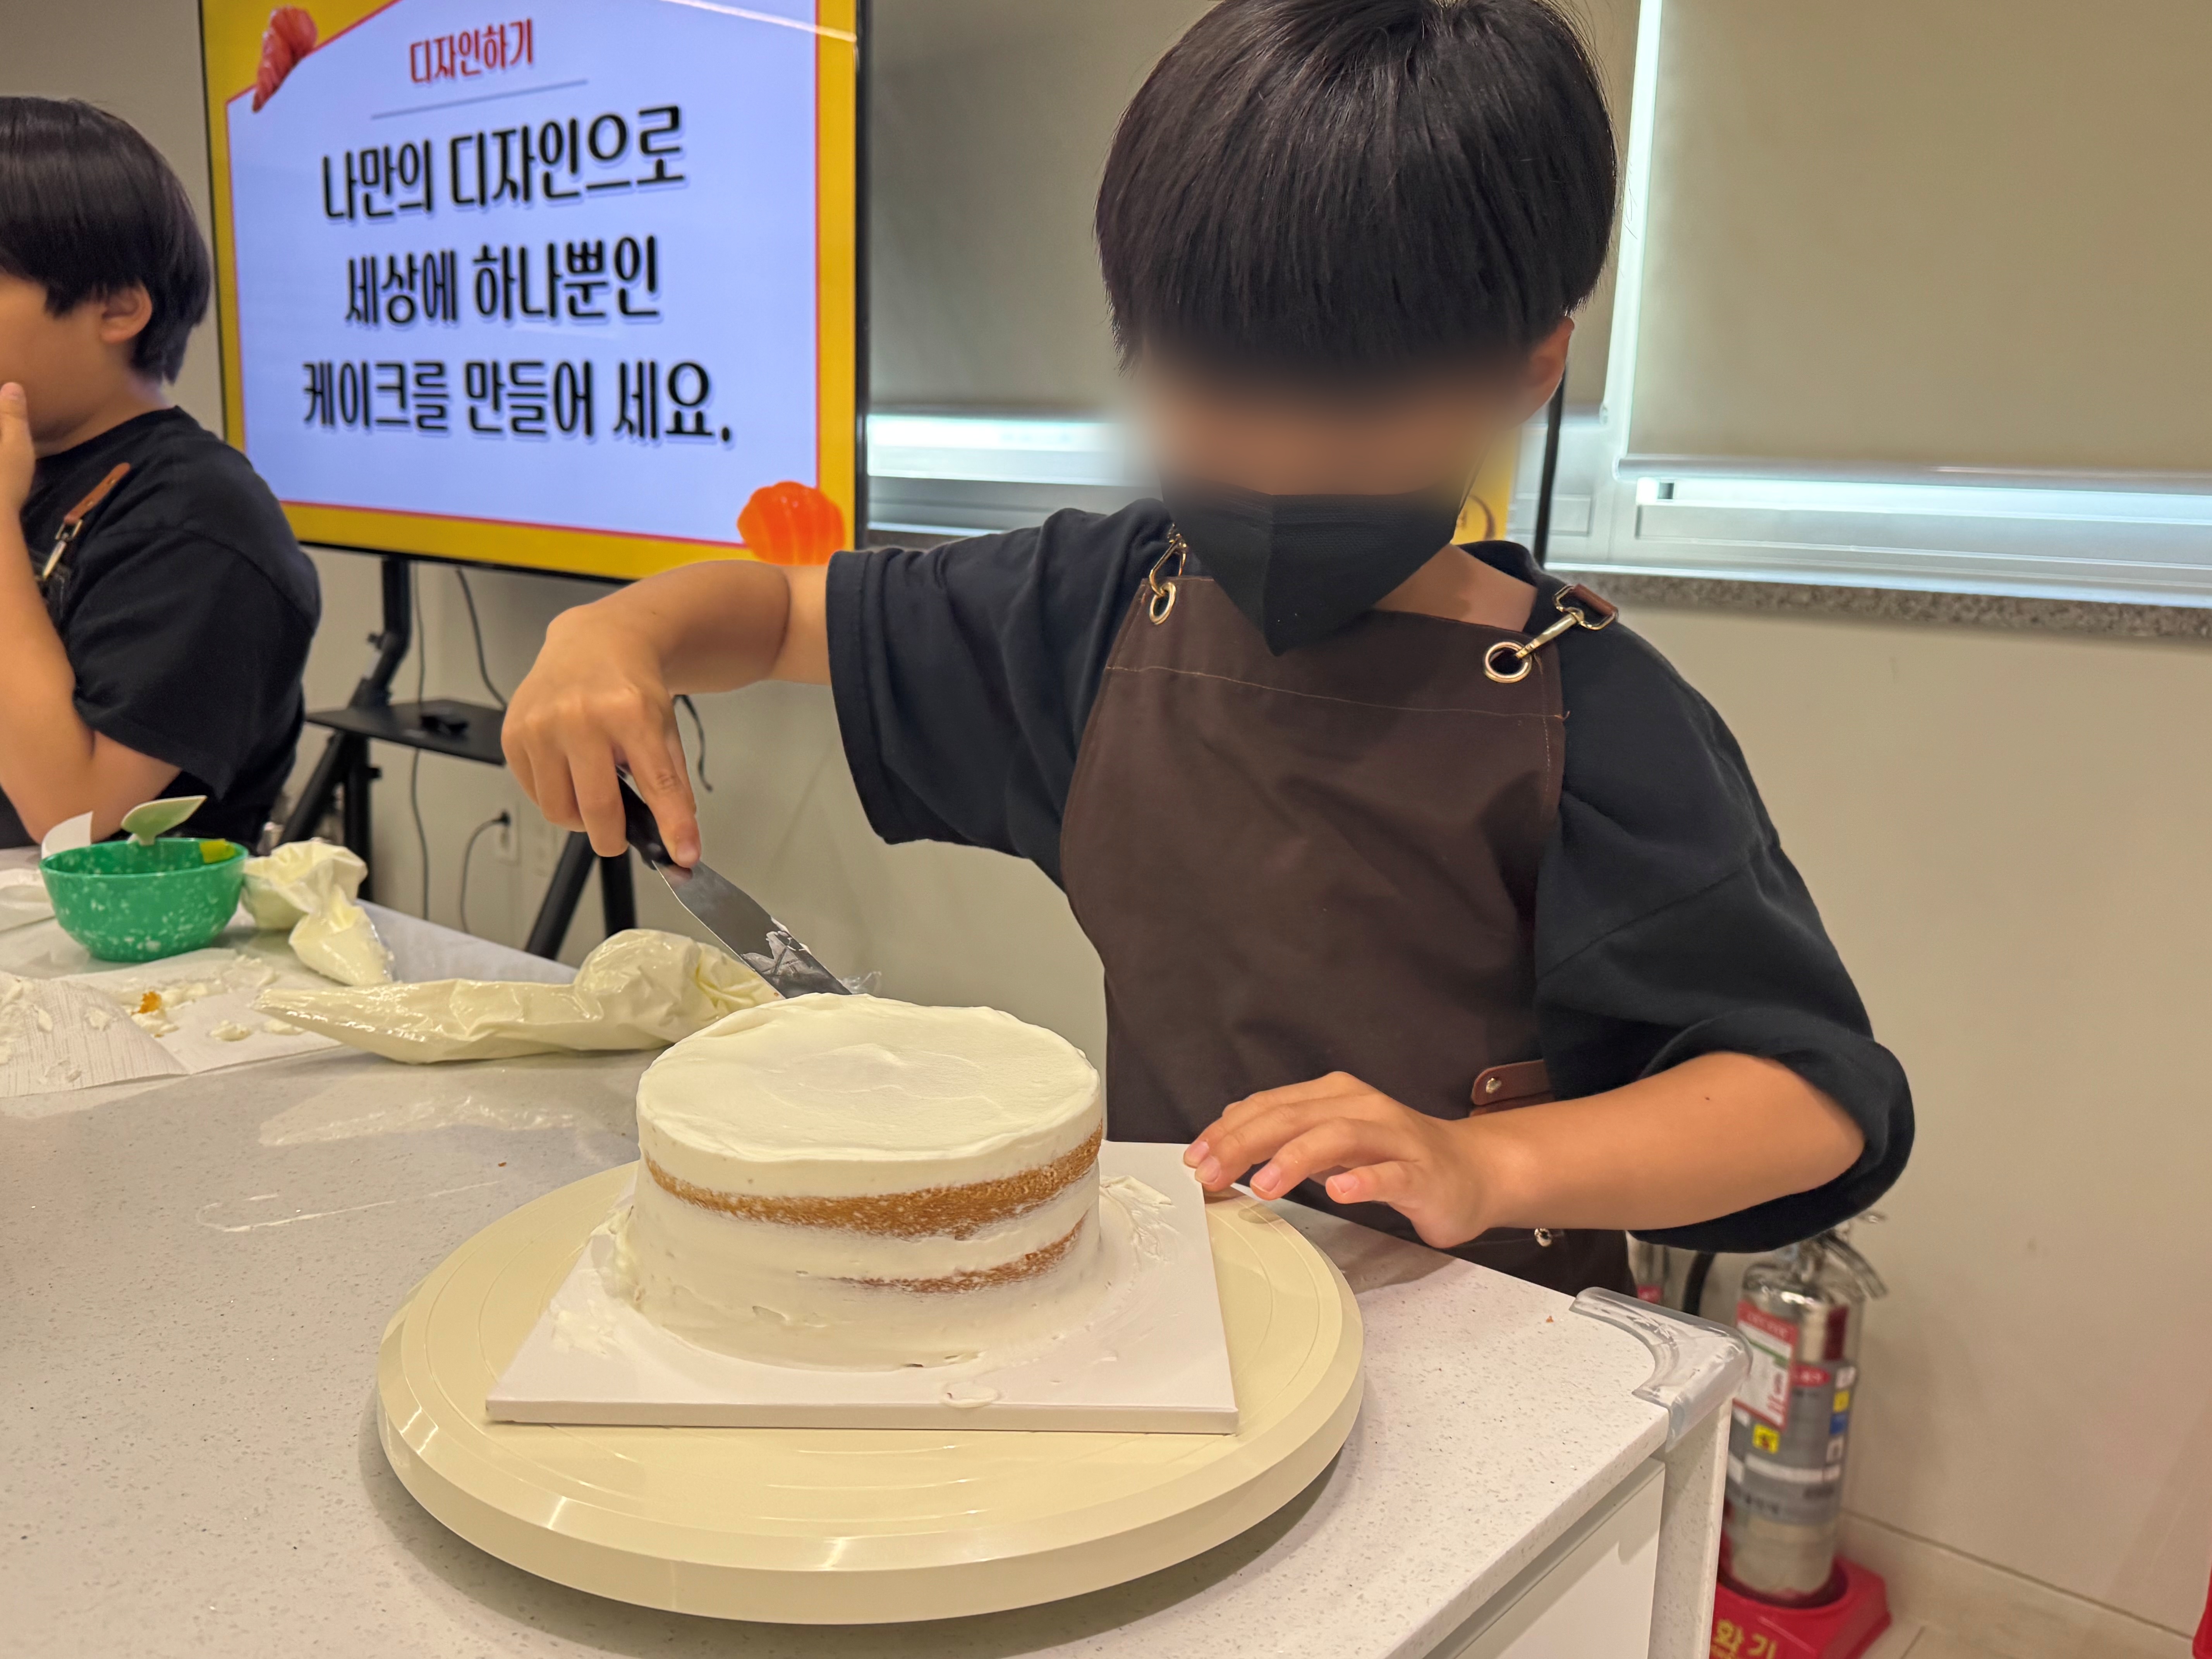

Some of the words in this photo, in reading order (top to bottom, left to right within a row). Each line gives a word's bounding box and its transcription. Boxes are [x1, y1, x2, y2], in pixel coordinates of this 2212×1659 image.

[410, 18, 533, 83] 디자인하기
[322, 139, 434, 220] 나만의
[449, 105, 685, 207] 디자인으로
[345, 249, 459, 325] 세상에
[472, 235, 659, 321] 하나뿐인
[302, 361, 450, 431] 케이크를
[464, 360, 594, 437] 만들어
[613, 360, 732, 442] 세요.
[1713, 1619, 1777, 1659] 화기
